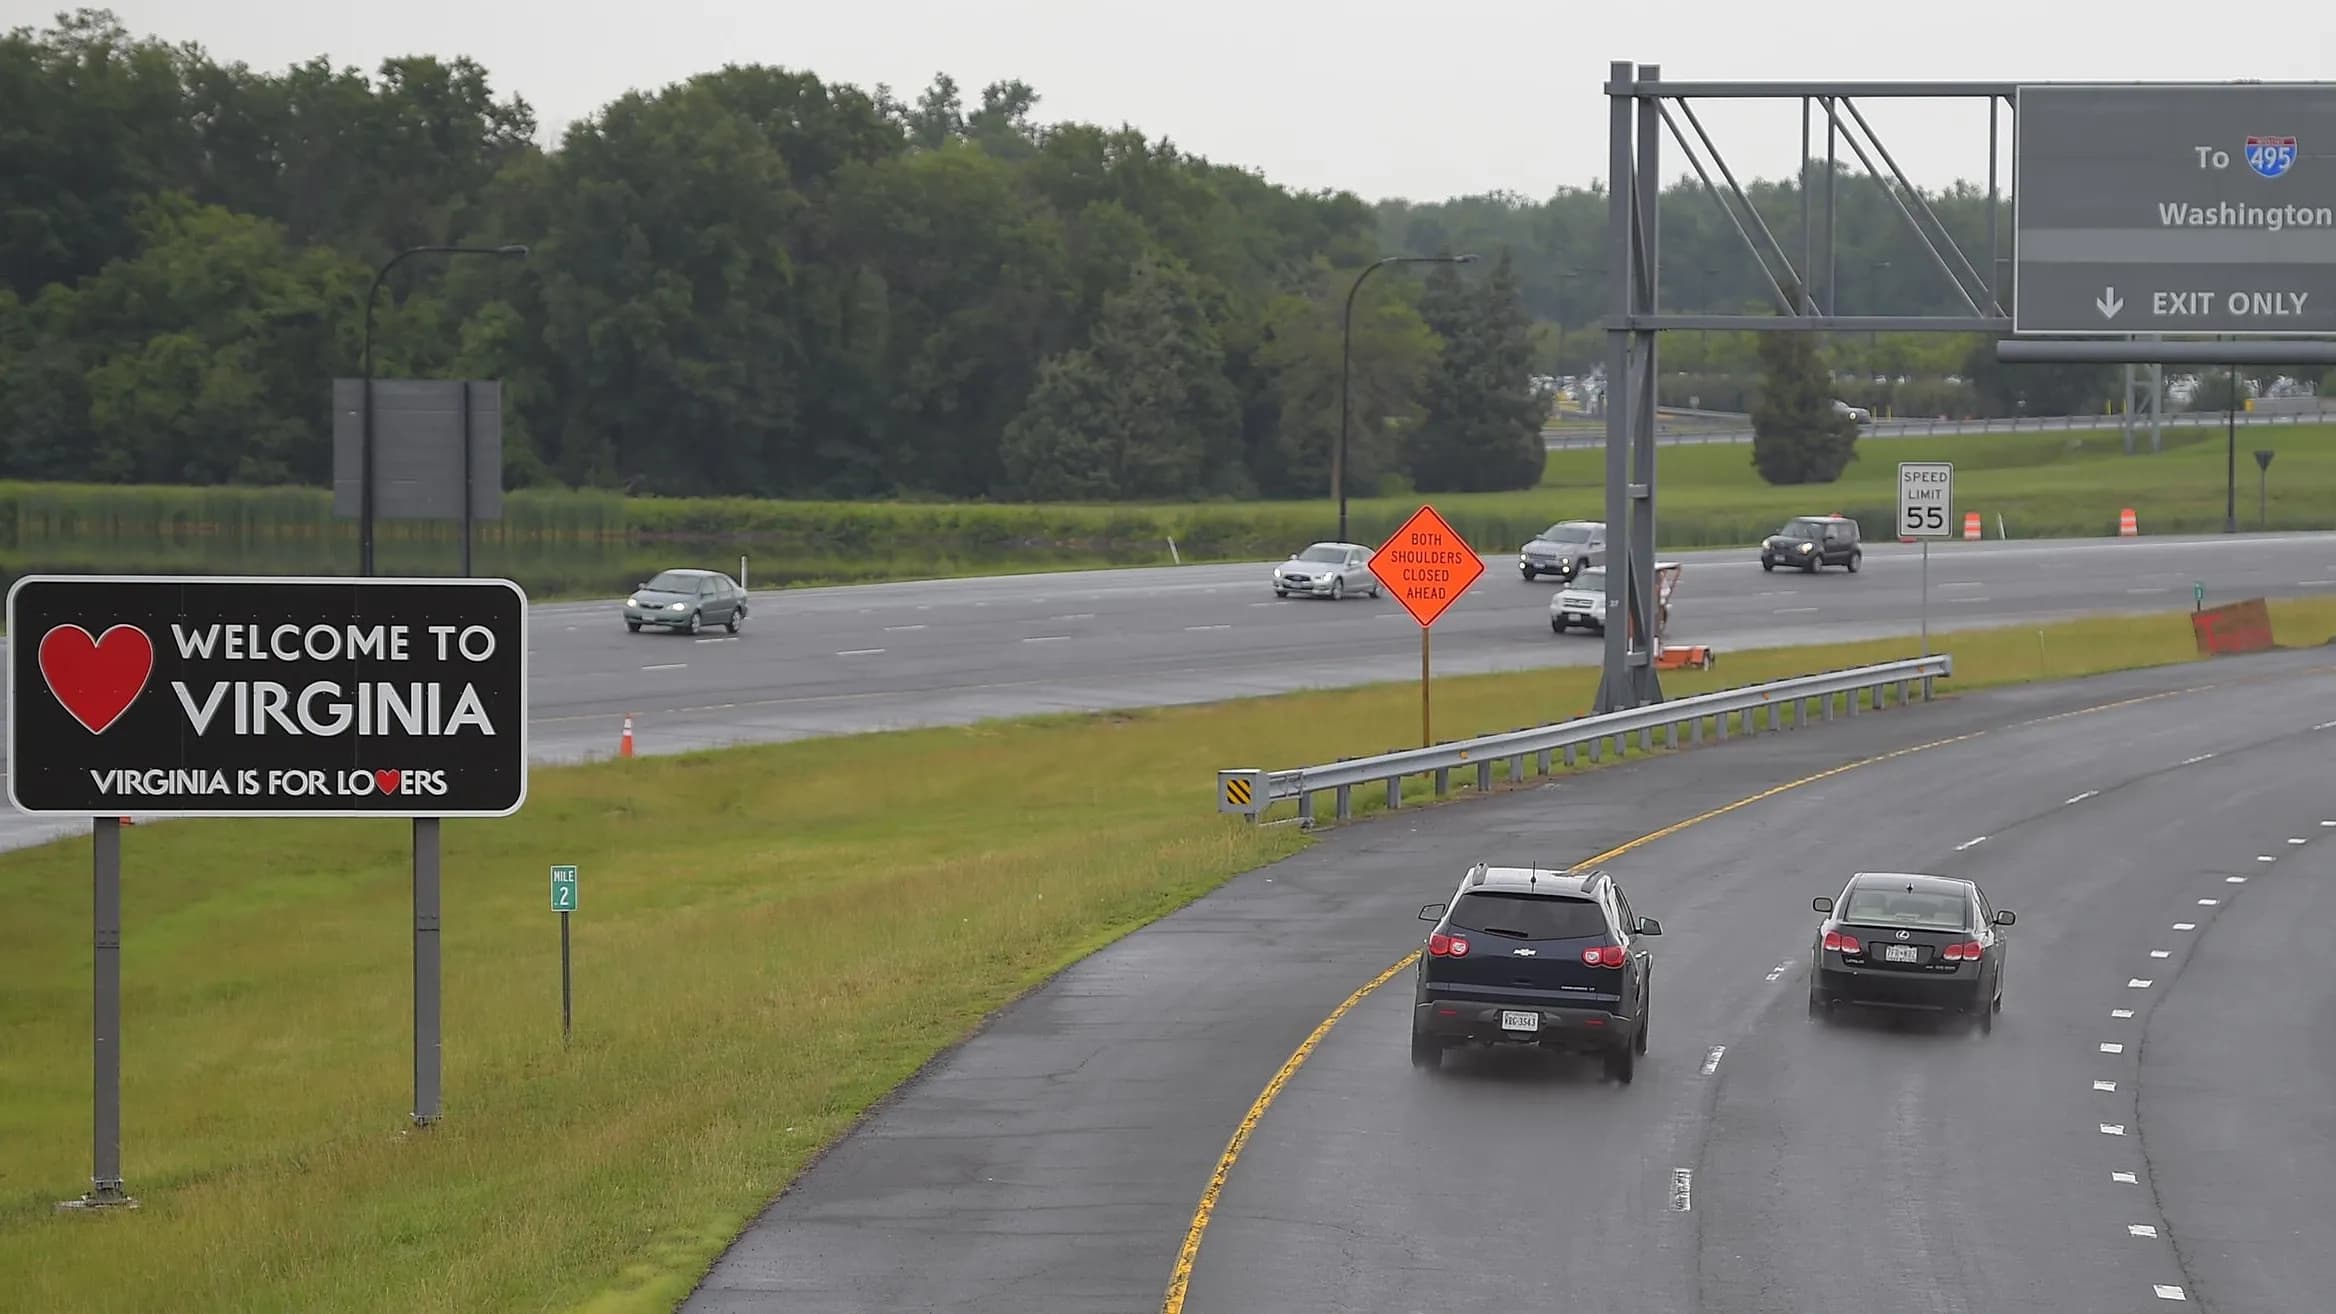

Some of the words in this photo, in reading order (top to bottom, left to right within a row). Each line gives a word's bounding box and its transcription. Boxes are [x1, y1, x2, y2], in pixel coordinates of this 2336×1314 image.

[2195, 146, 2230, 169] To
[2251, 147, 2291, 169] 495
[2159, 202, 2332, 231] Washington
[2153, 292, 2215, 315] EXIT
[2228, 292, 2309, 315] ONLY
[1904, 472, 1948, 482] SPEED
[1908, 489, 1943, 500] LIMIT
[1907, 507, 1943, 529] 55
[1411, 533, 1442, 545] BOTH
[1391, 551, 1462, 564] SHOULDERS
[1403, 569, 1449, 581] CLOSED
[1407, 587, 1446, 599] AHEAD
[171, 623, 410, 662] WELCOME
[428, 626, 497, 662] TO
[171, 681, 497, 737] VIRGINIA
[90, 768, 231, 797] VIRGINIA
[237, 769, 260, 796] IS
[267, 770, 331, 796] FOR
[554, 870, 574, 882] MILE
